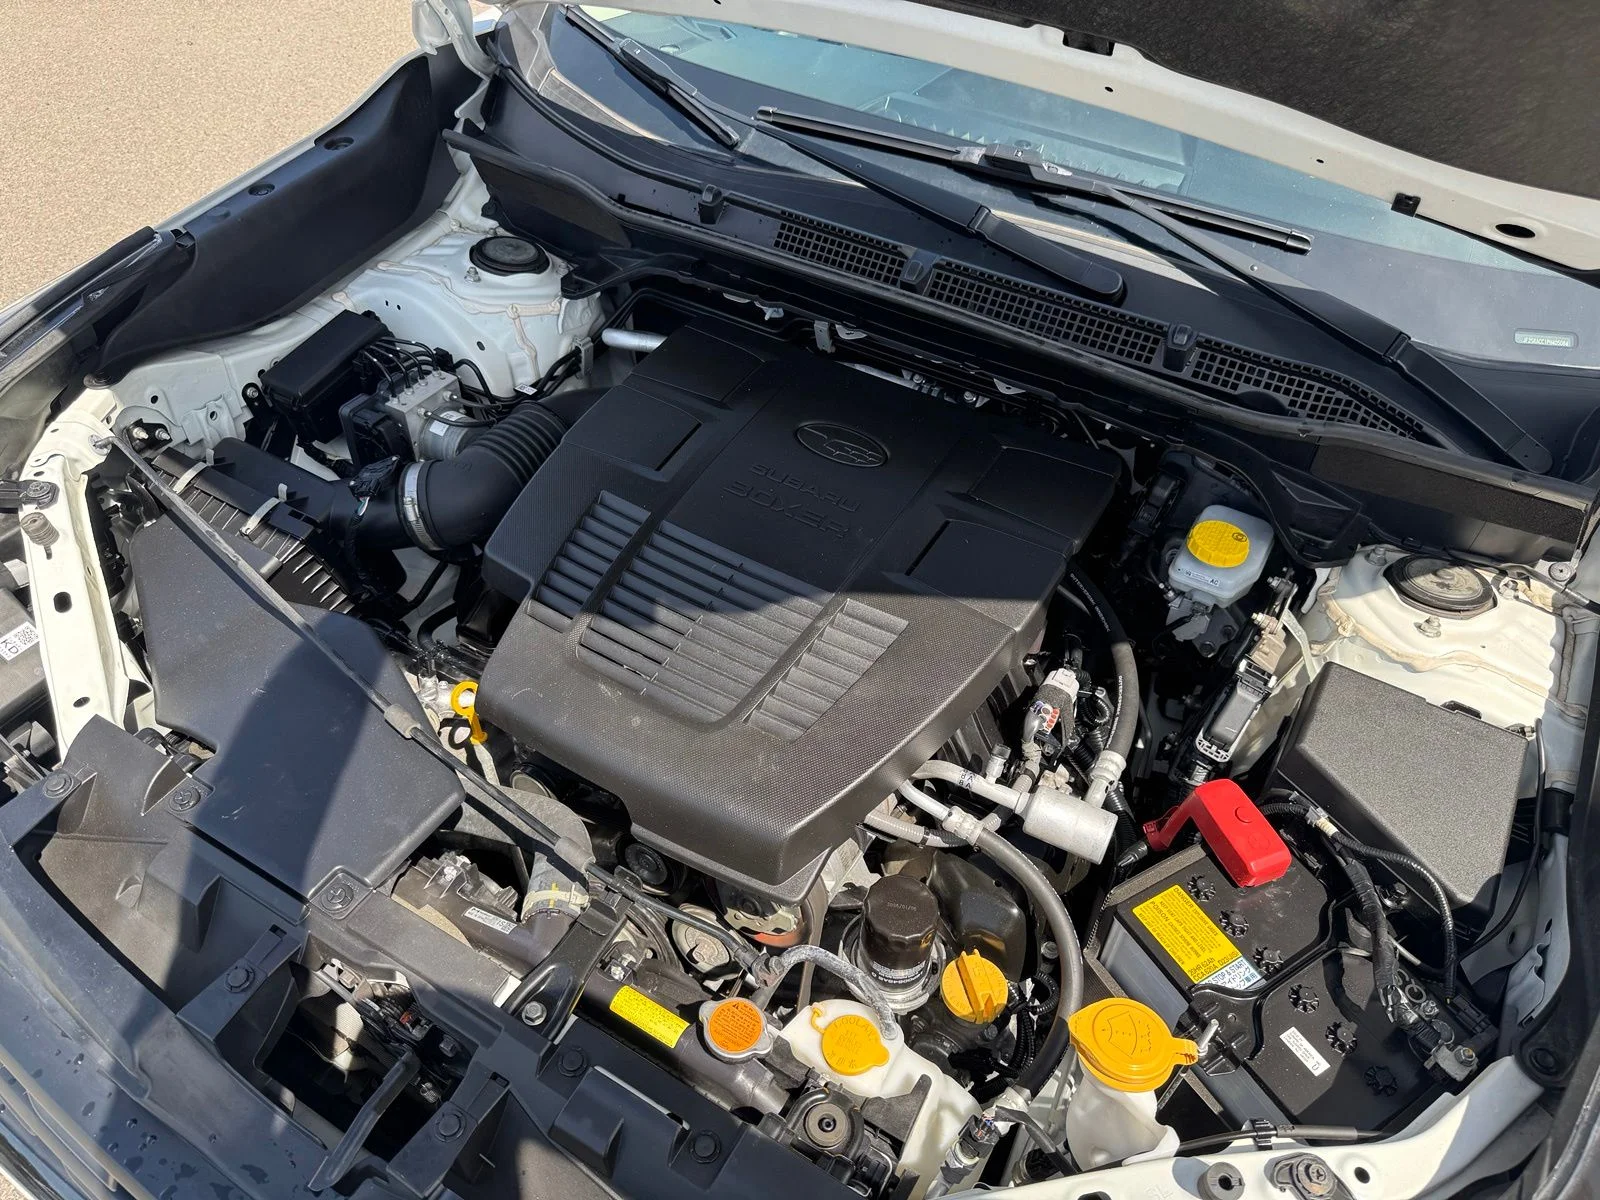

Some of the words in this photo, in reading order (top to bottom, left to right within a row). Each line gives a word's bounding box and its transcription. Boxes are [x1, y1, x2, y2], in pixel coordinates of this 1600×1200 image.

[750, 464, 862, 512] SUBARU
[722, 480, 848, 538] BOXER
[1172, 887, 1195, 908] DANGER
[1148, 900, 1170, 922] POISON
[1212, 971, 1226, 984] STOP
[1229, 960, 1246, 974] START
